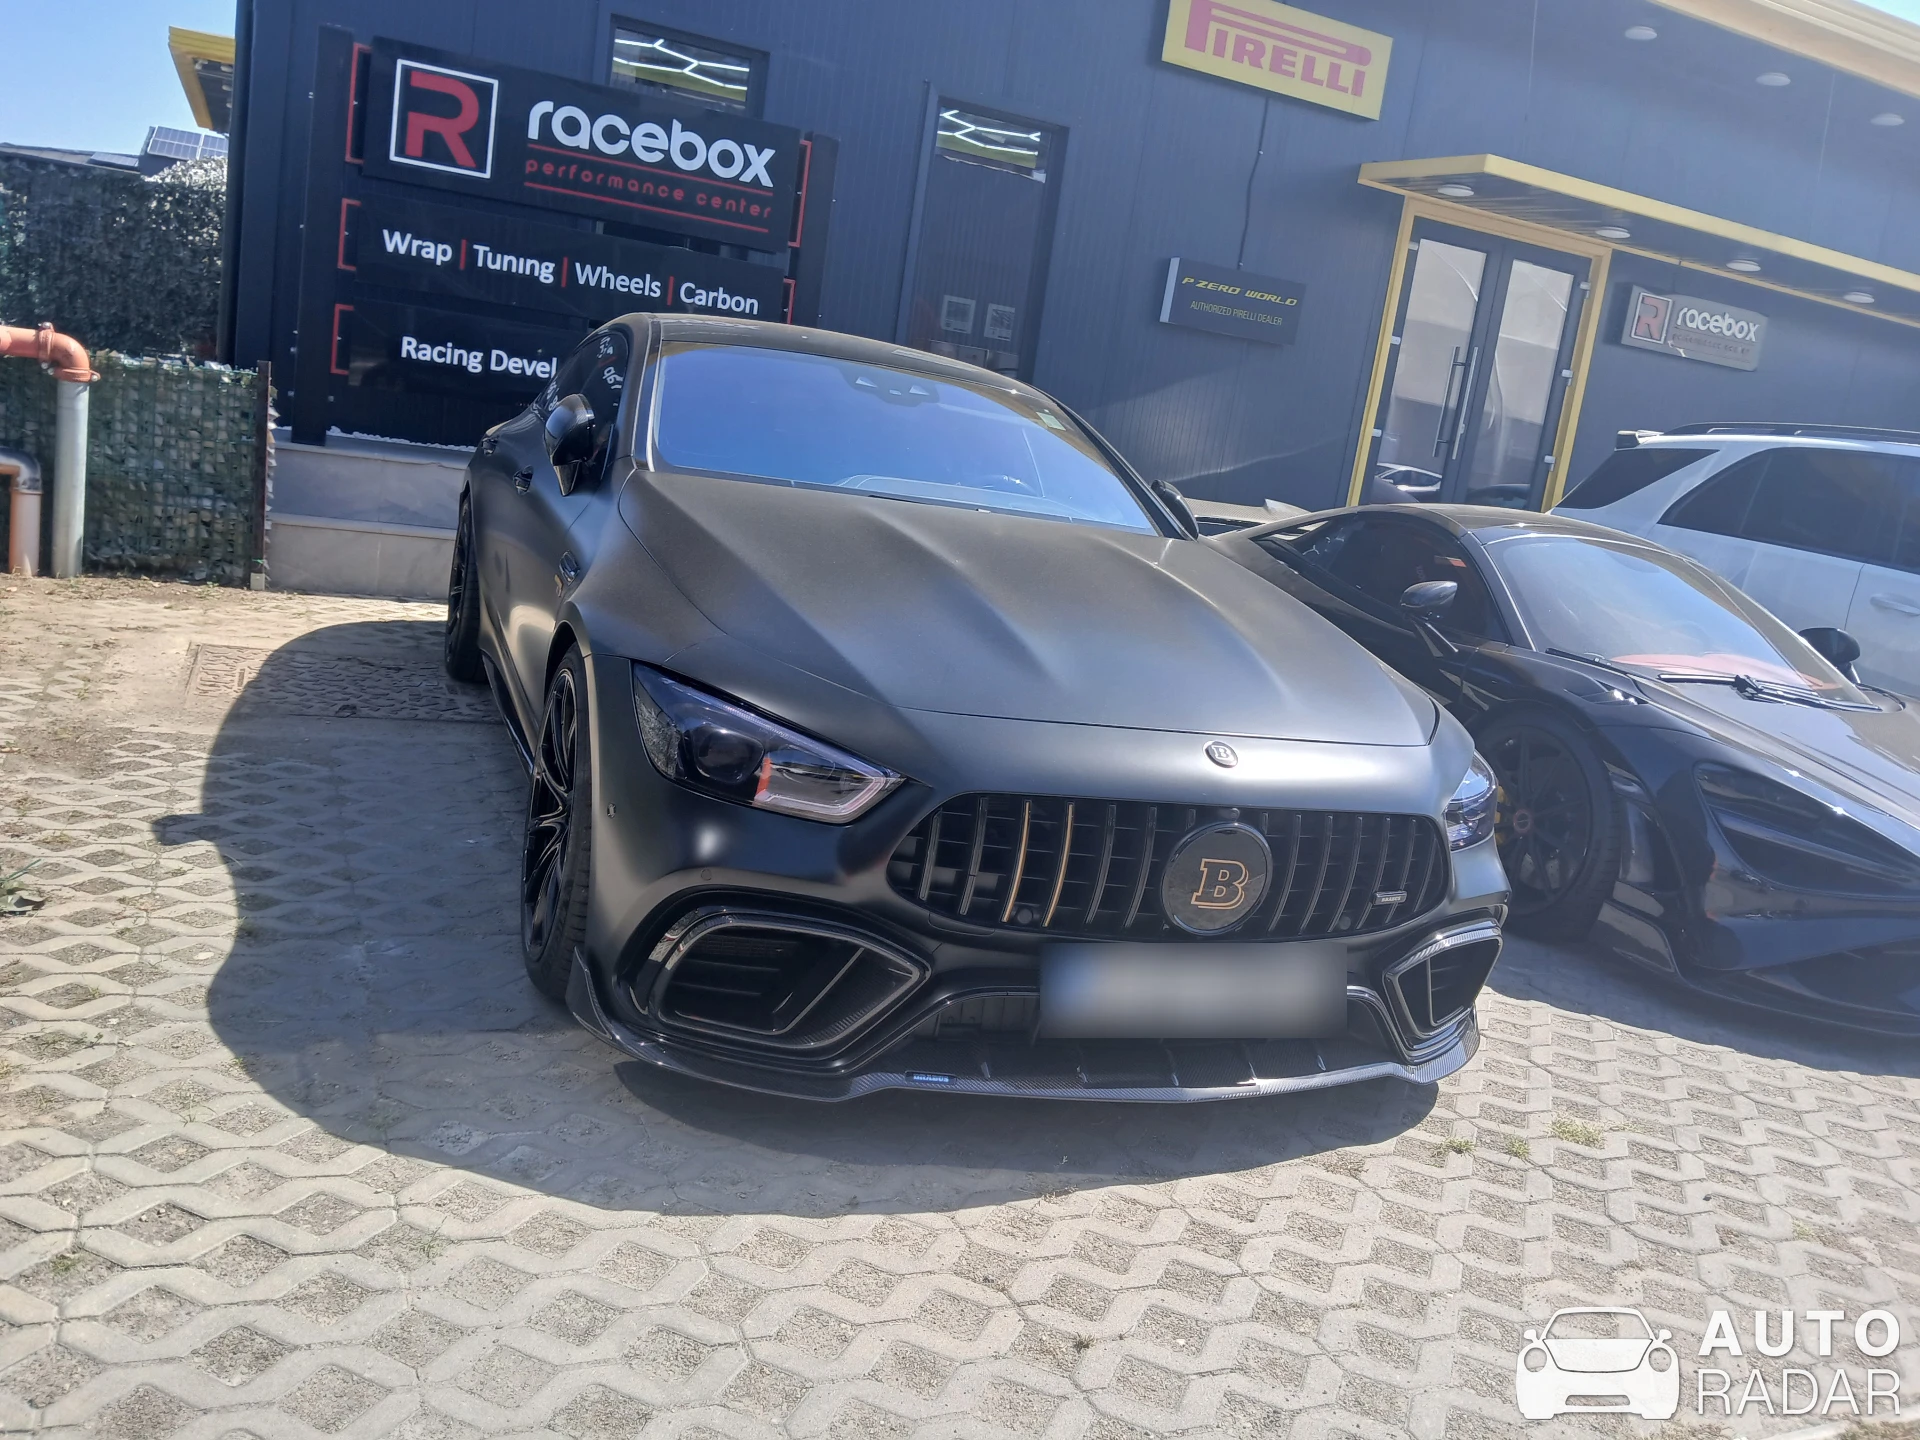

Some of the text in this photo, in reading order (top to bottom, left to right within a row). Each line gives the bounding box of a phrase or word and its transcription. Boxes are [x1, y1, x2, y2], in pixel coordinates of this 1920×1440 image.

[1184, 0, 1372, 98] PIRELLI
[405, 71, 480, 168] R
[528, 100, 776, 187] racebox
[525, 159, 772, 218] performance center
[382, 229, 759, 315] Wrap Tuning Wheels Carbon
[1182, 277, 1298, 306] P ZERO WORLD
[1190, 300, 1283, 326] AUTHORIZED PIRELLI DEALER
[1676, 307, 1760, 342] racebox
[401, 336, 483, 374] Racing
[1191, 858, 1249, 910] B
